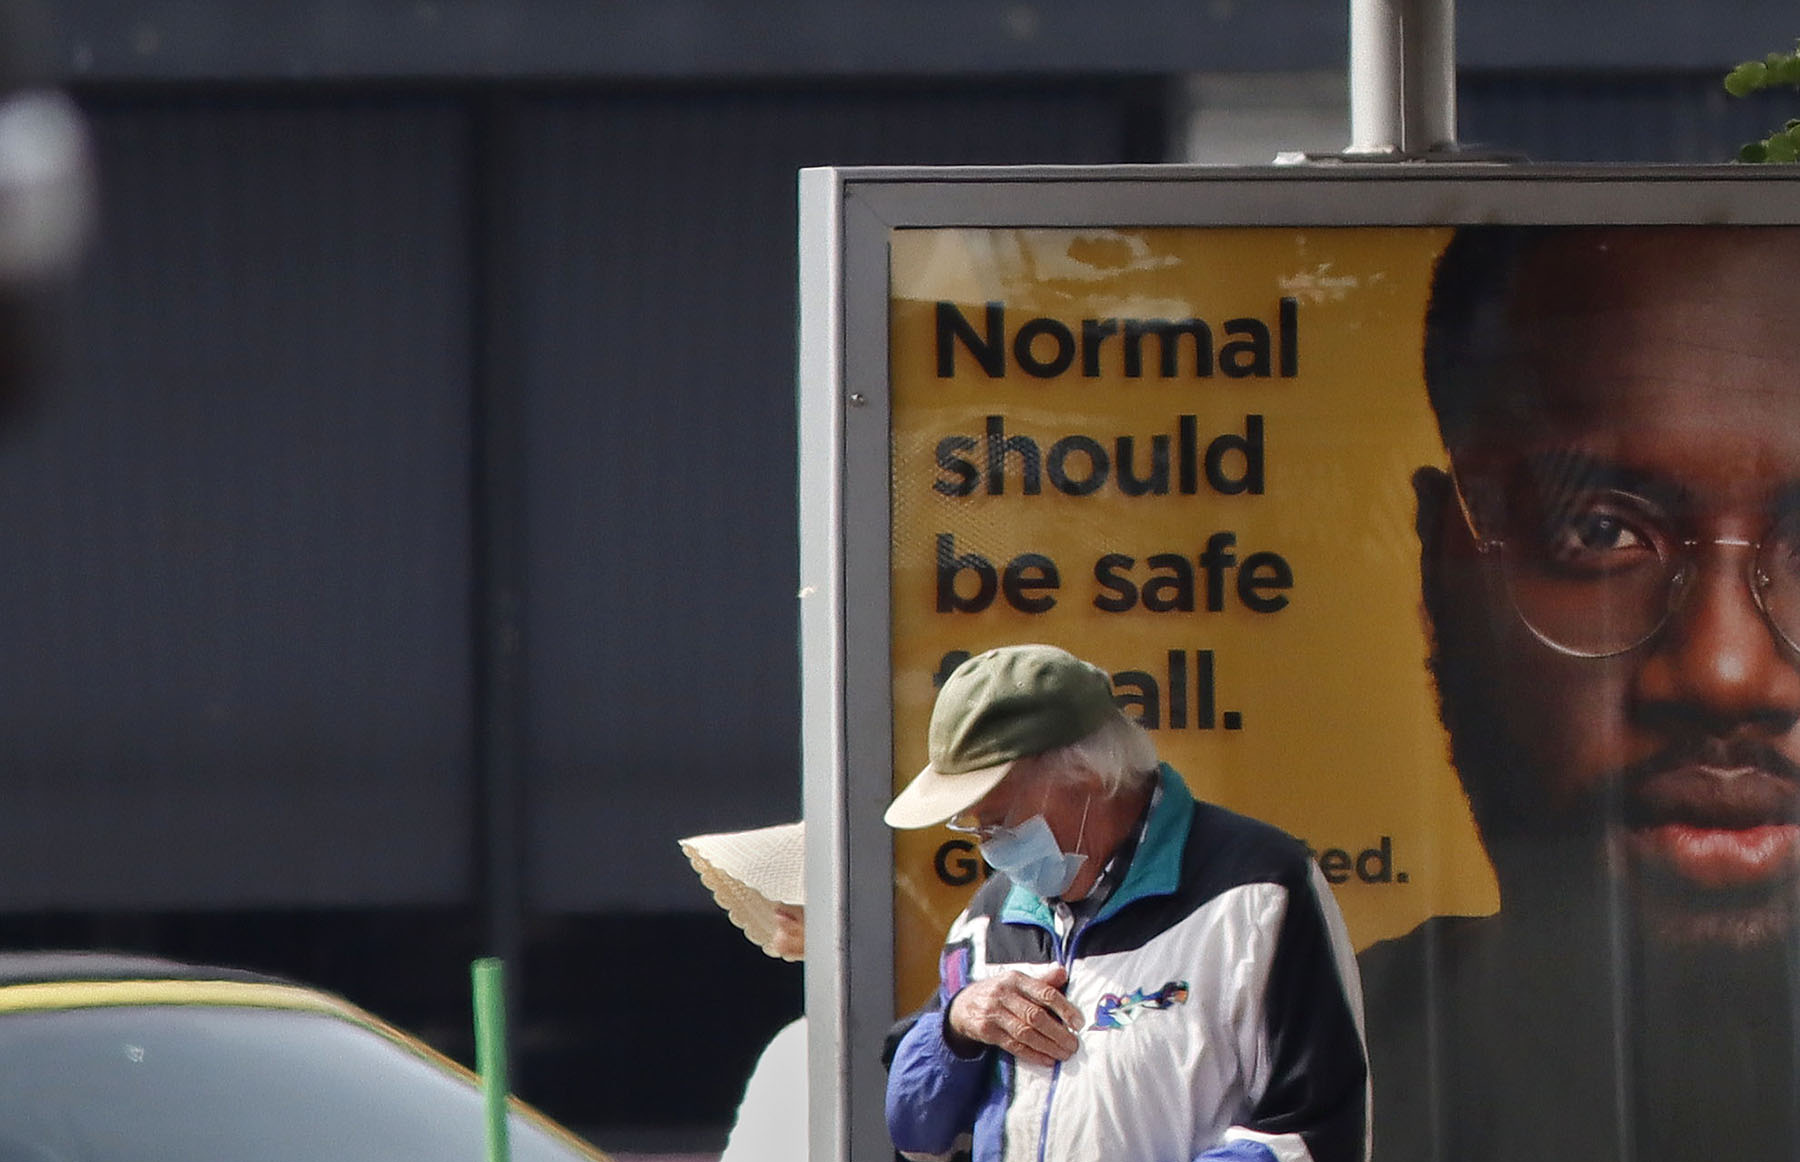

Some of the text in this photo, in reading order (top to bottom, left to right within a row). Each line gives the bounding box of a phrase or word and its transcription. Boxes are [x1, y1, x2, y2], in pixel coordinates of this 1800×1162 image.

[935, 297, 1299, 379] Normal
[933, 414, 1265, 497] should
[935, 532, 1294, 614] be safe
